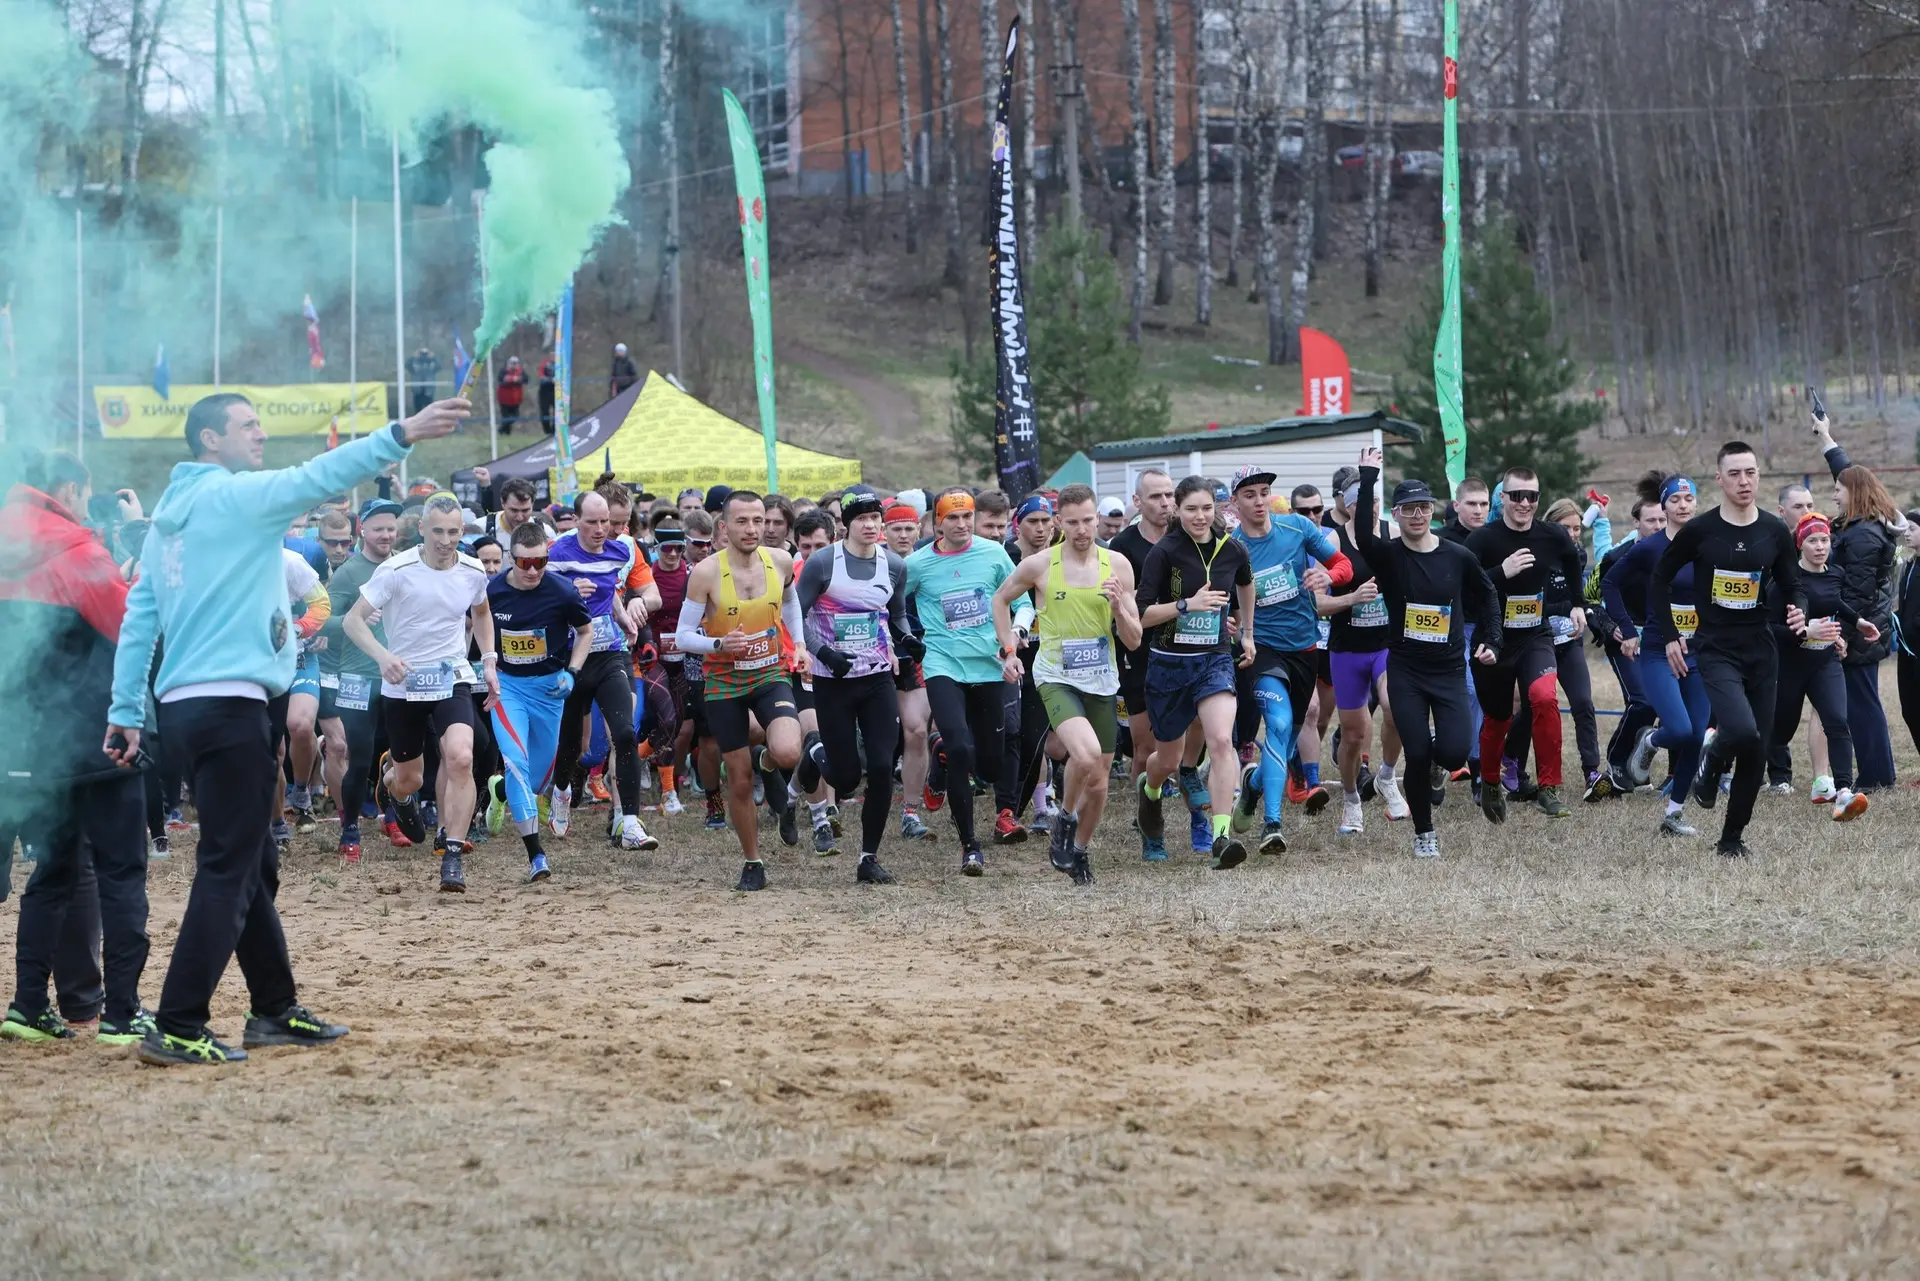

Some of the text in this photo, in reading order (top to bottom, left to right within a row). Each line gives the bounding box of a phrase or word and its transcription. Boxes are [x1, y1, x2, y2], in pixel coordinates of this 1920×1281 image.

[140, 403, 189, 417] ХИМК
[1264, 574, 1288, 590] 455
[1724, 581, 1750, 594] 953
[953, 599, 978, 615] 299
[1361, 603, 1384, 614] 464
[1515, 603, 1537, 615] 958
[1187, 616, 1212, 629] 403
[1415, 614, 1440, 628] 952
[1675, 614, 1696, 626] 914
[845, 623, 870, 635] 463
[510, 640, 536, 651] 916
[745, 640, 769, 656] 758
[1074, 648, 1099, 662] 298
[416, 673, 442, 686] 301
[340, 682, 361, 695] 342
